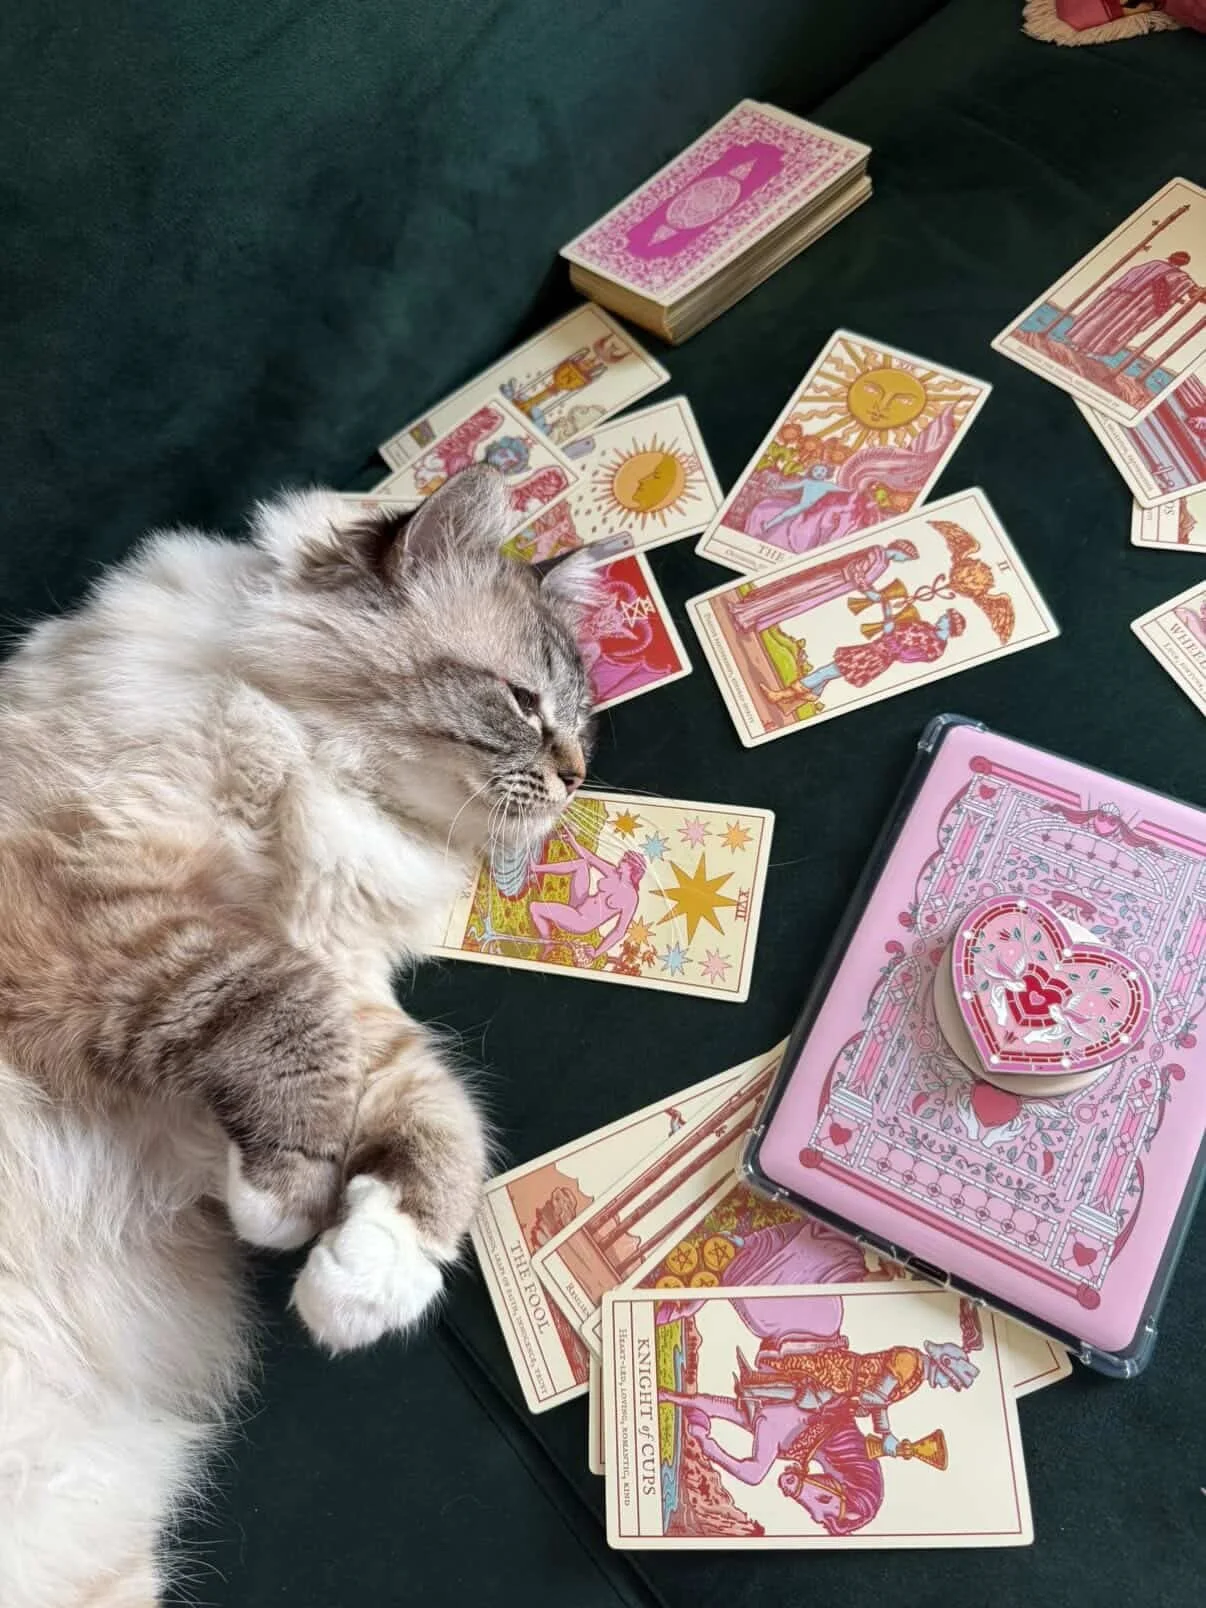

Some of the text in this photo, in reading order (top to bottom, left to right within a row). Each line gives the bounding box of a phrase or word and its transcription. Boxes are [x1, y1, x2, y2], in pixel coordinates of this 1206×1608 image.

[758, 543, 784, 562] THE
[734, 887, 751, 922] XVII
[510, 1240, 551, 1335] THE FOOL
[638, 1337, 656, 1496] KNIGHT of CUPS
